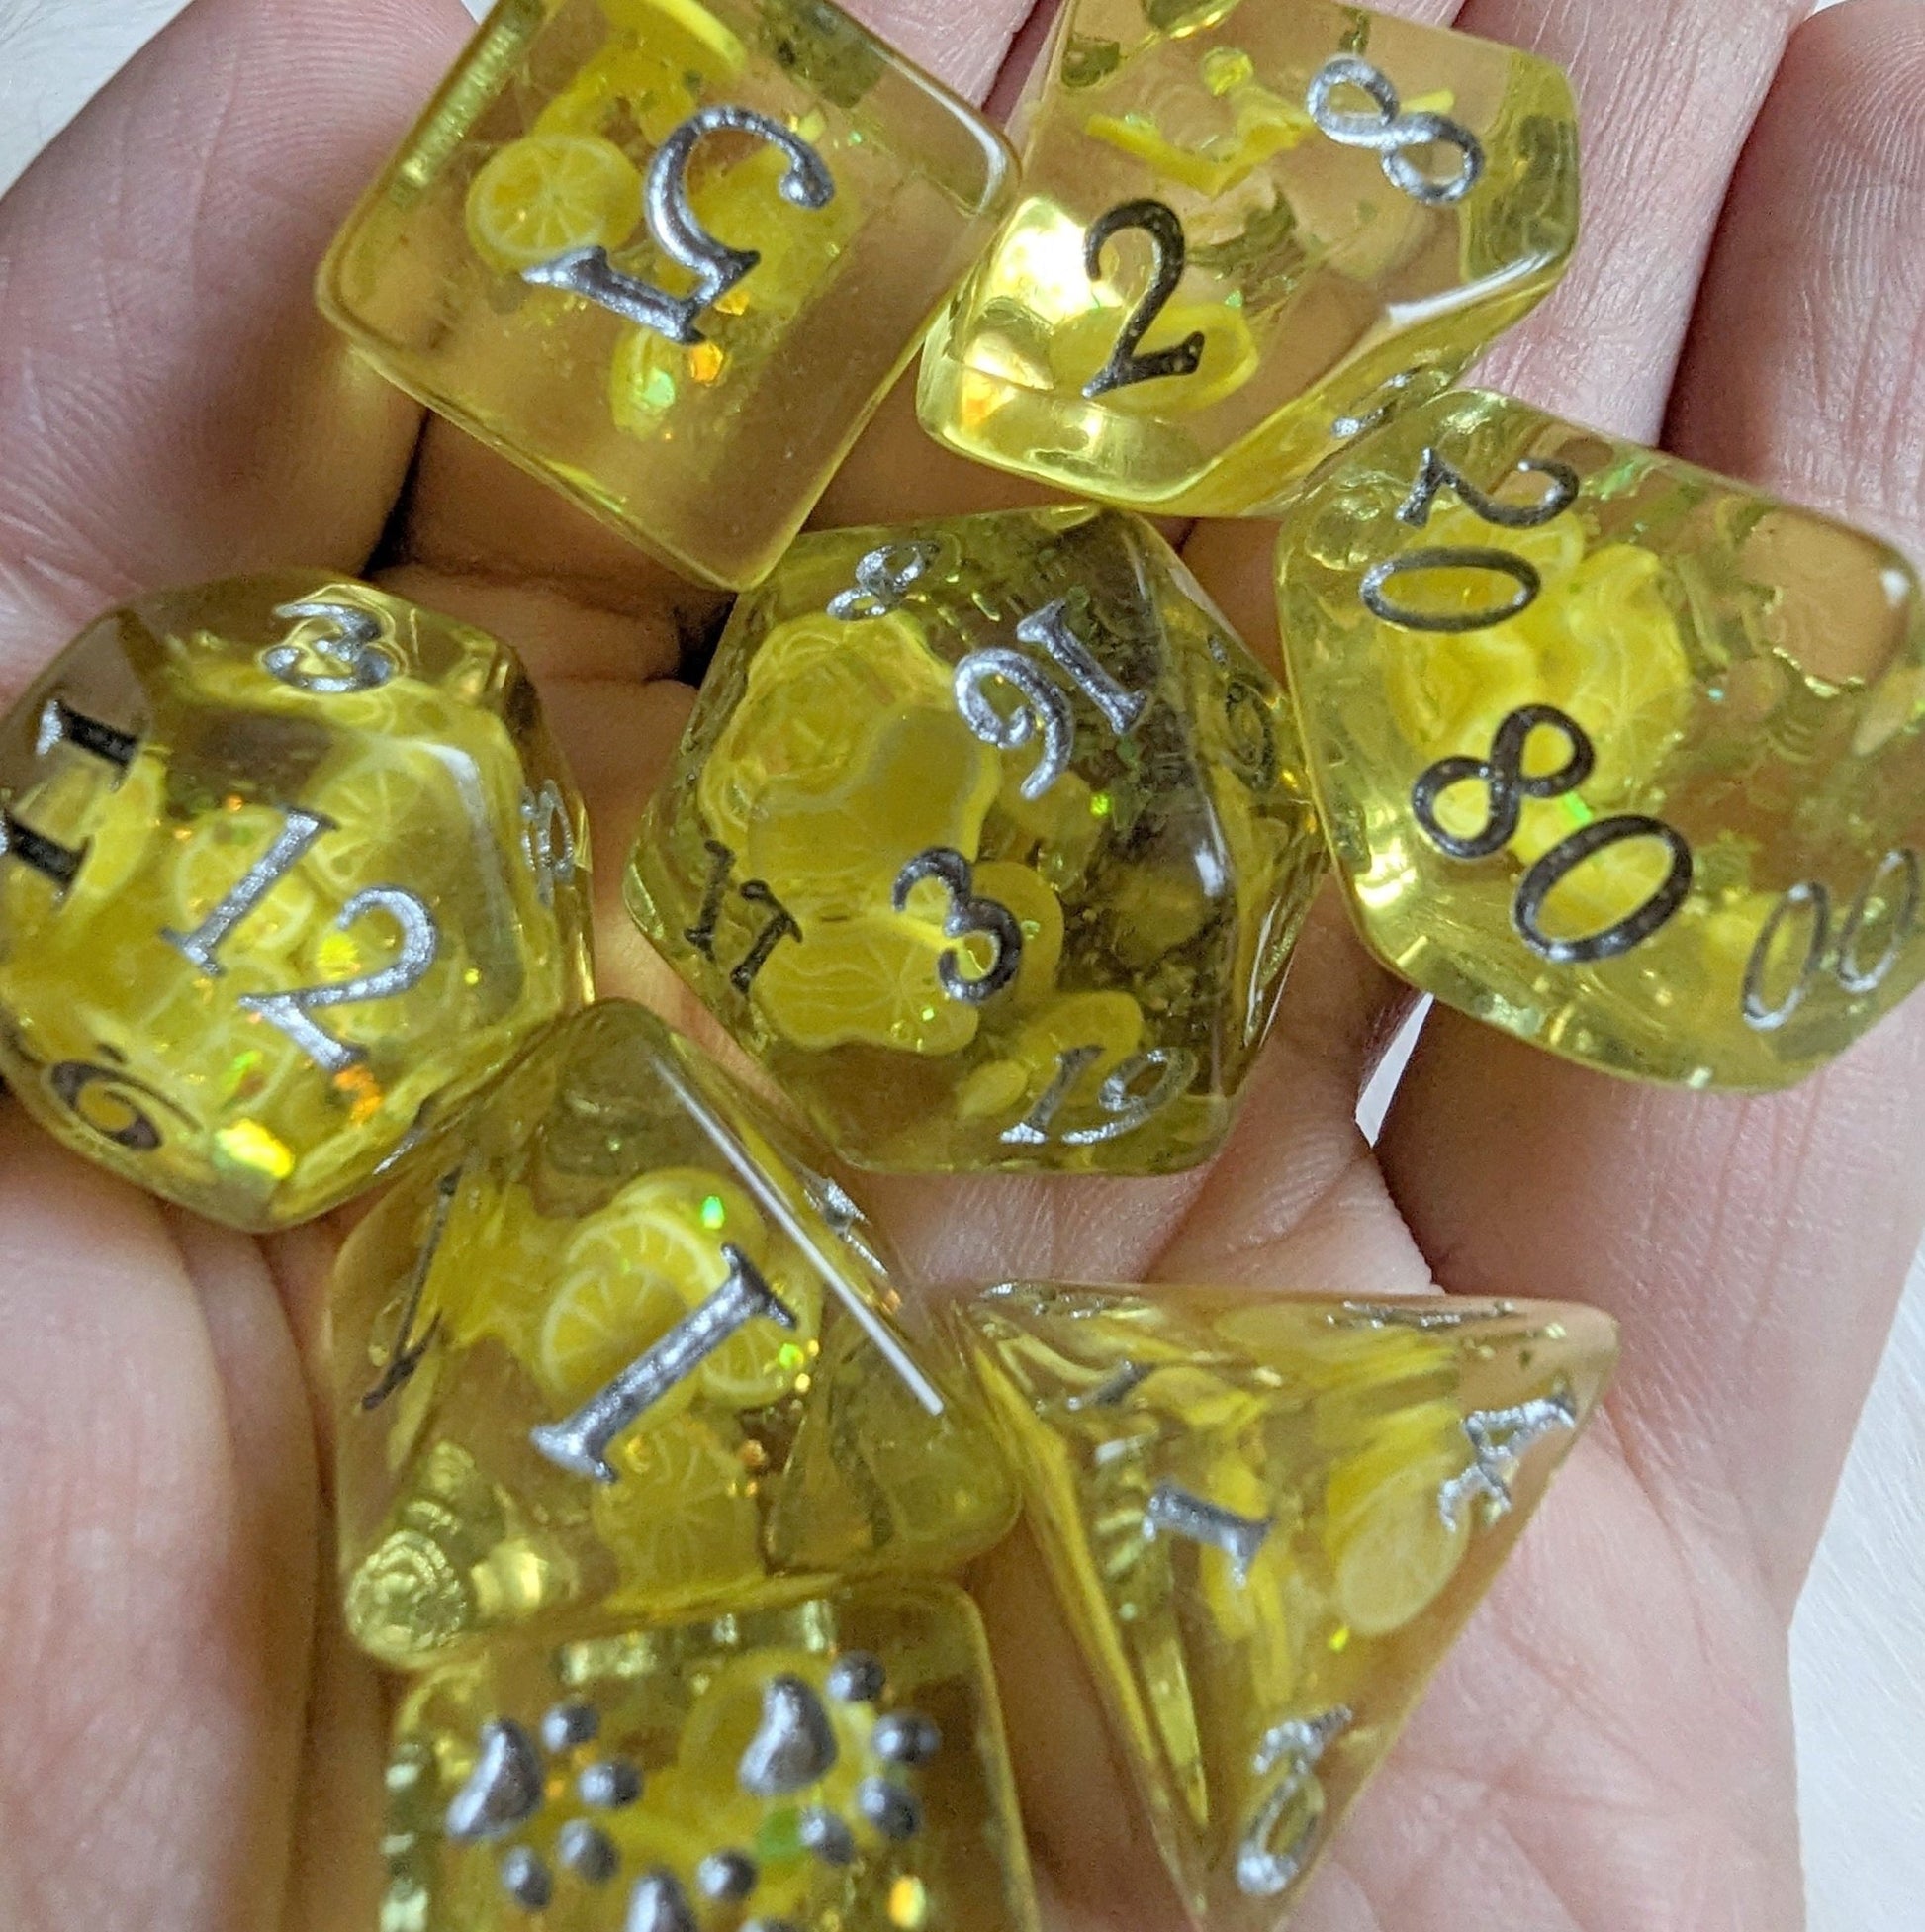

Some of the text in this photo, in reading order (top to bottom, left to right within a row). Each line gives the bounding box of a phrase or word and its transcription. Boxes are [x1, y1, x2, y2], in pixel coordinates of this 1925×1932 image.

[1306, 52, 1485, 206] 8
[522, 105, 835, 346] 5
[1084, 198, 1205, 398] 2
[826, 541, 938, 621] 8
[1359, 447, 1580, 633] 20
[261, 601, 393, 692] 3
[893, 845, 1024, 1005] 3
[1412, 703, 1695, 964] 80
[159, 802, 437, 1071] 12
[1741, 849, 1920, 1031] 00
[999, 1043, 1199, 1145] 19
[530, 1242, 798, 1484] 1
